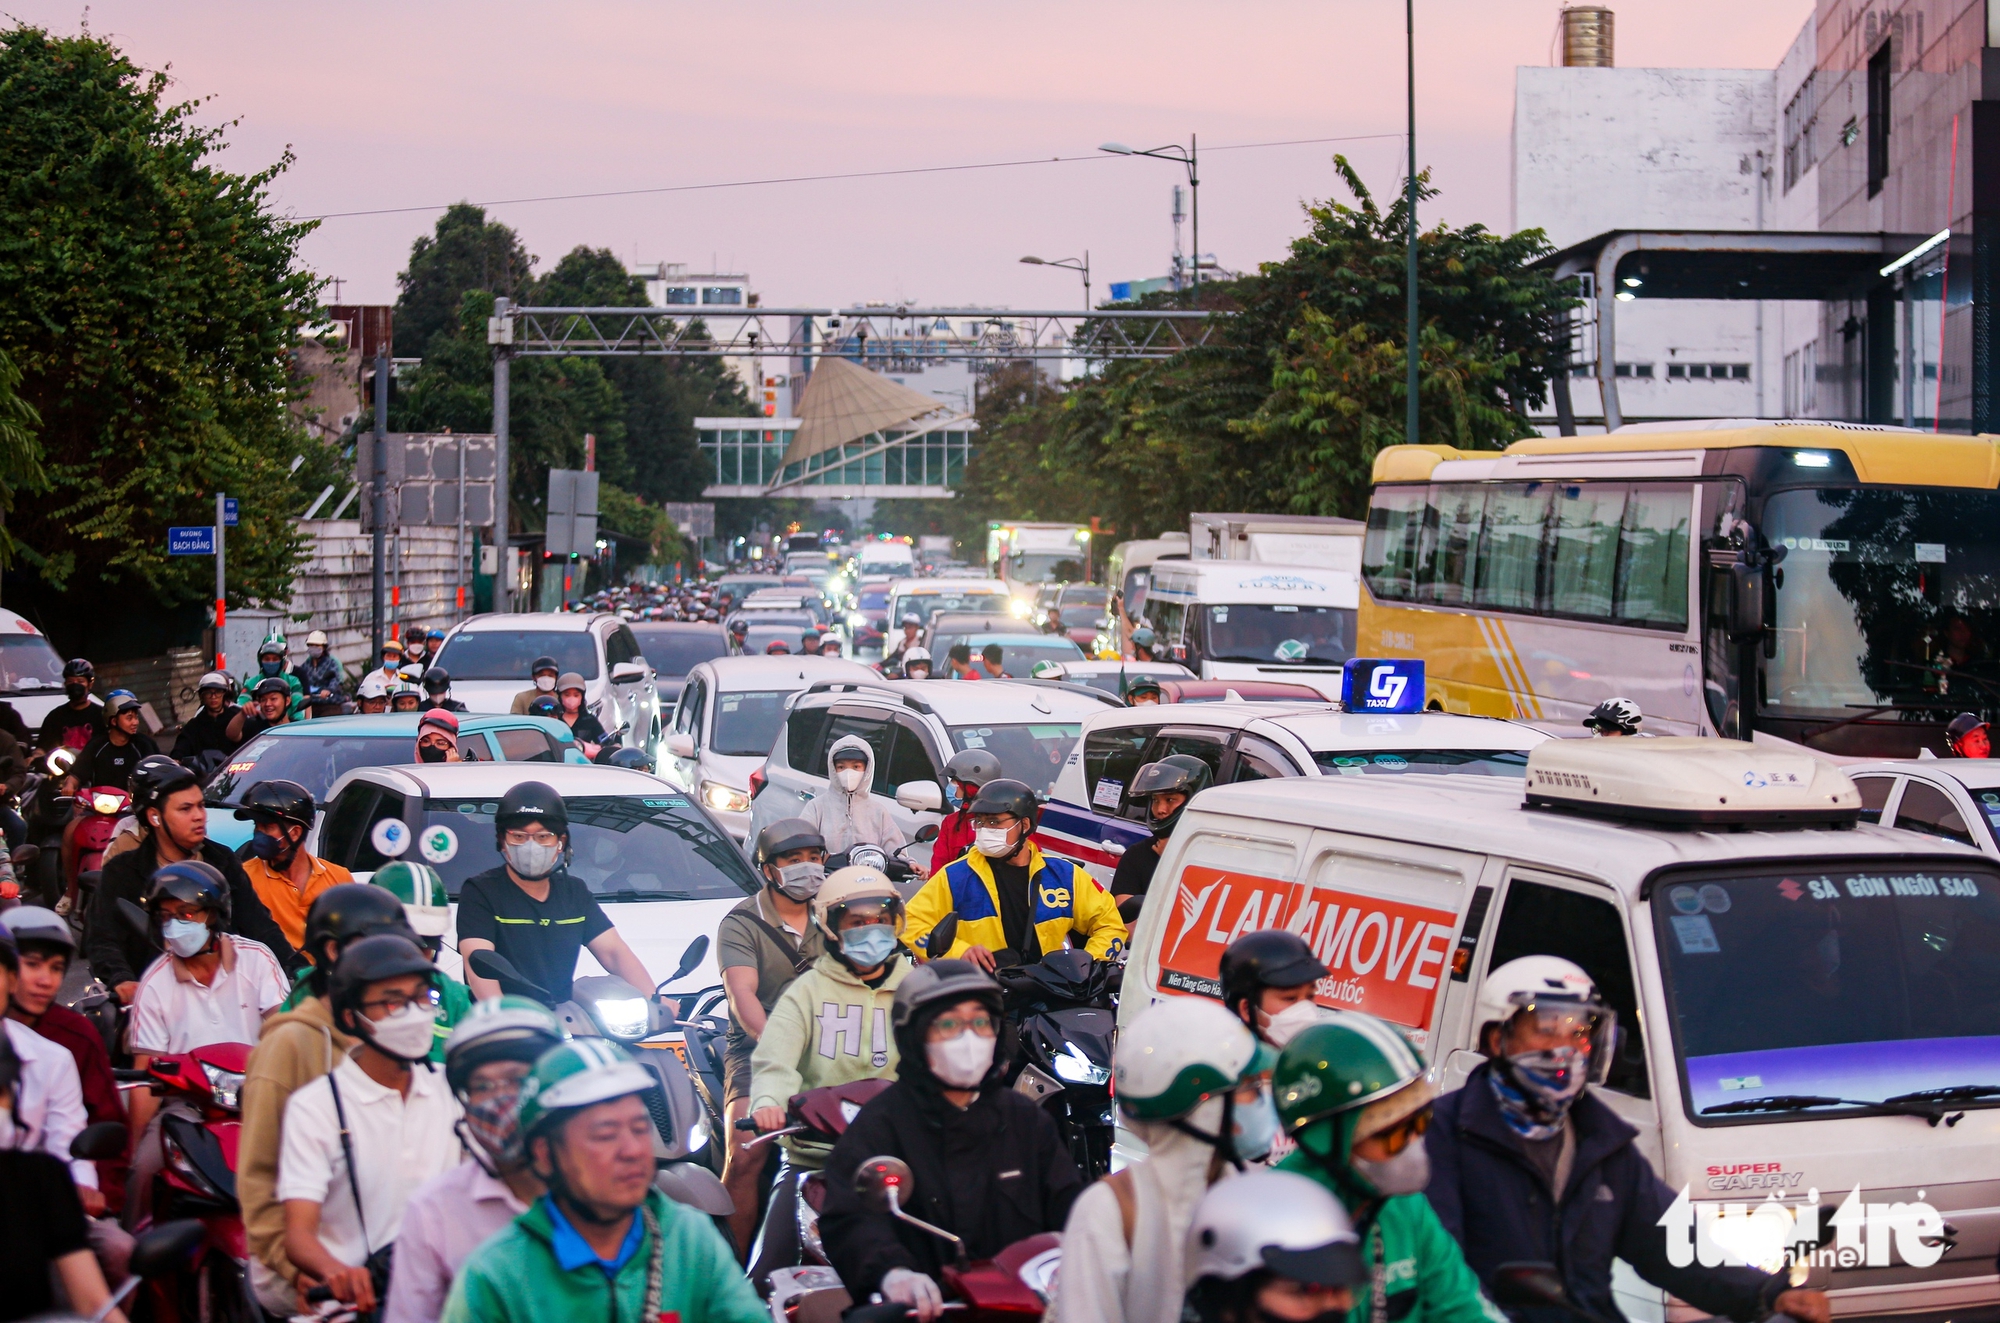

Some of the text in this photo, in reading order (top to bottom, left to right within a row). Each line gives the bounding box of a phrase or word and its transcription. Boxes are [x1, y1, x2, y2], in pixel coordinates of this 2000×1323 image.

[1369, 665, 1409, 708] G7
[1366, 699, 1387, 708] TAXI
[228, 762, 255, 773] TAXI
[1039, 883, 1071, 908] be
[1807, 873, 1979, 900] SÀ GÒN NGÔI SAO
[1314, 974, 1365, 1005] siêu tốc
[1706, 1162, 1782, 1176] SUPER
[1706, 1172, 1804, 1191] CARRY
